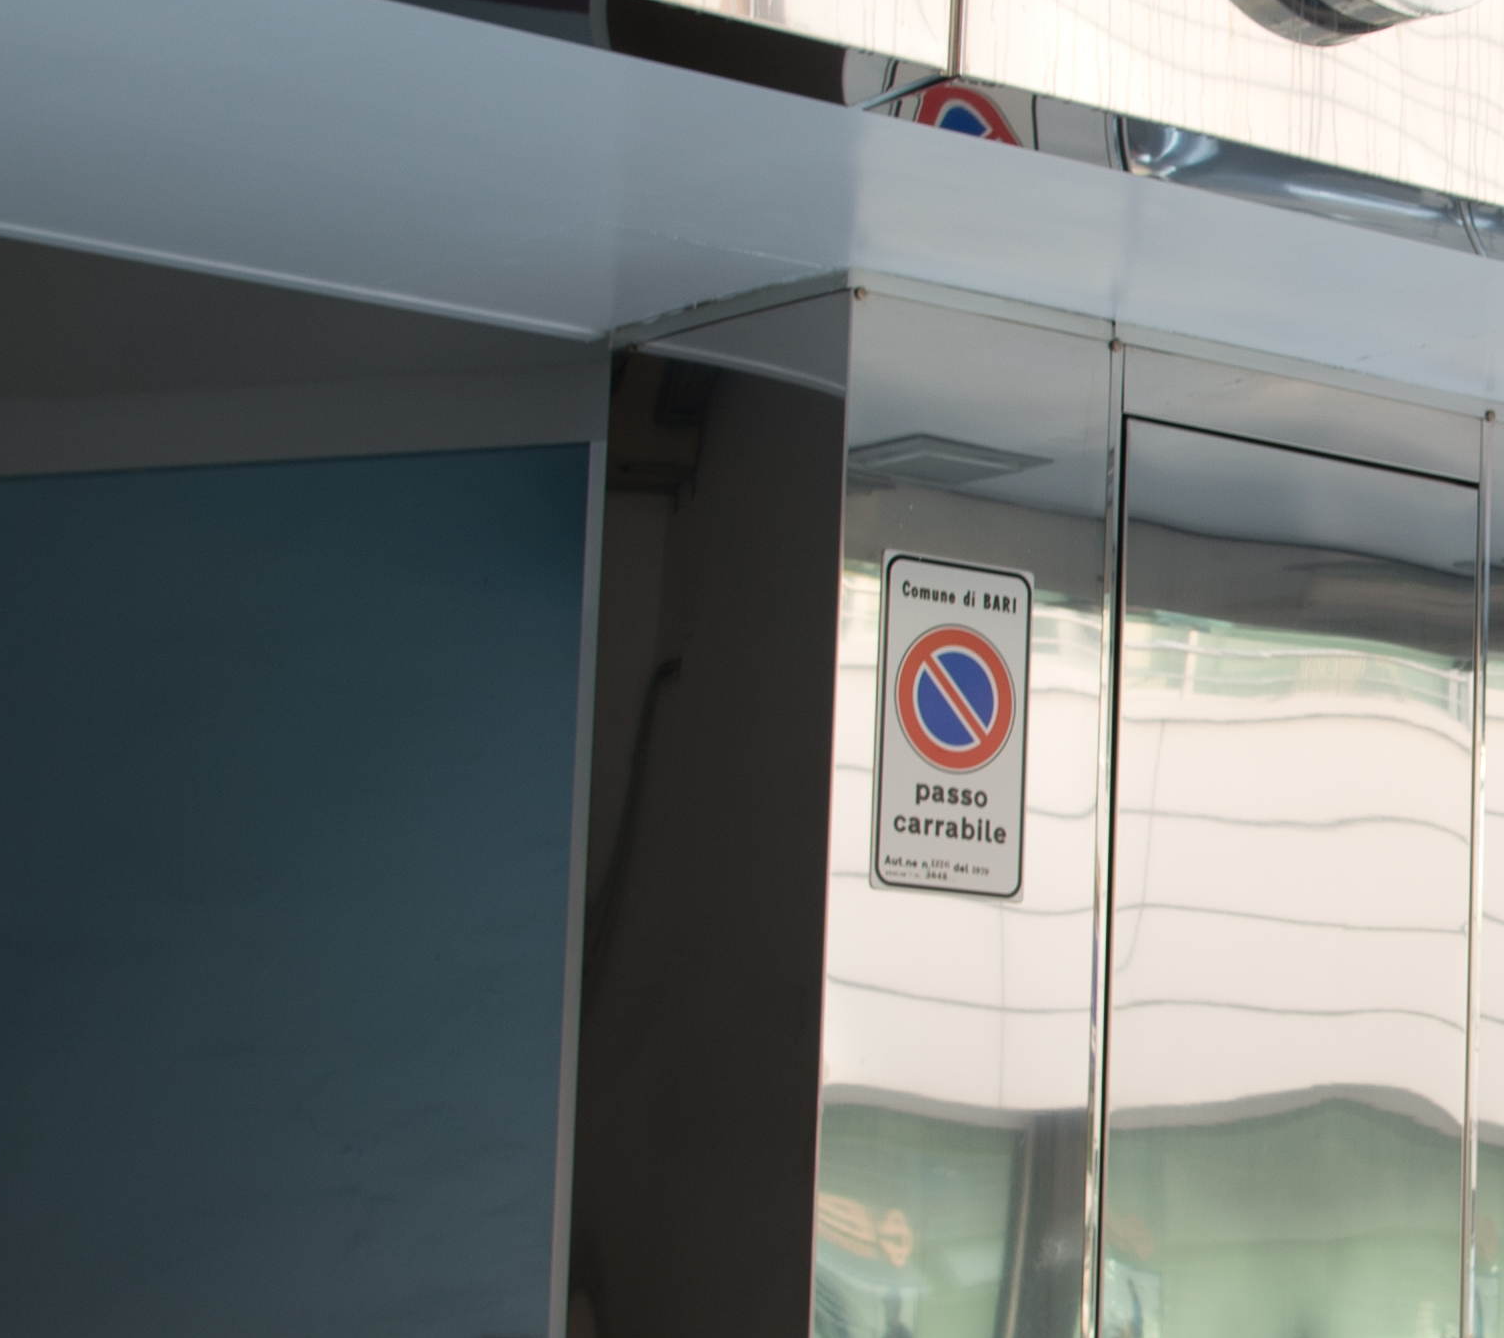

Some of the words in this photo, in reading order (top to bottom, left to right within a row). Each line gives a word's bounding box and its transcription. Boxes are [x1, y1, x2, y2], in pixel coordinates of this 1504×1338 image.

[902, 580, 956, 605] Comune
[963, 590, 976, 608] di
[983, 593, 1017, 614] BARI
[915, 783, 988, 808] passo
[893, 815, 1007, 844] carrabile
